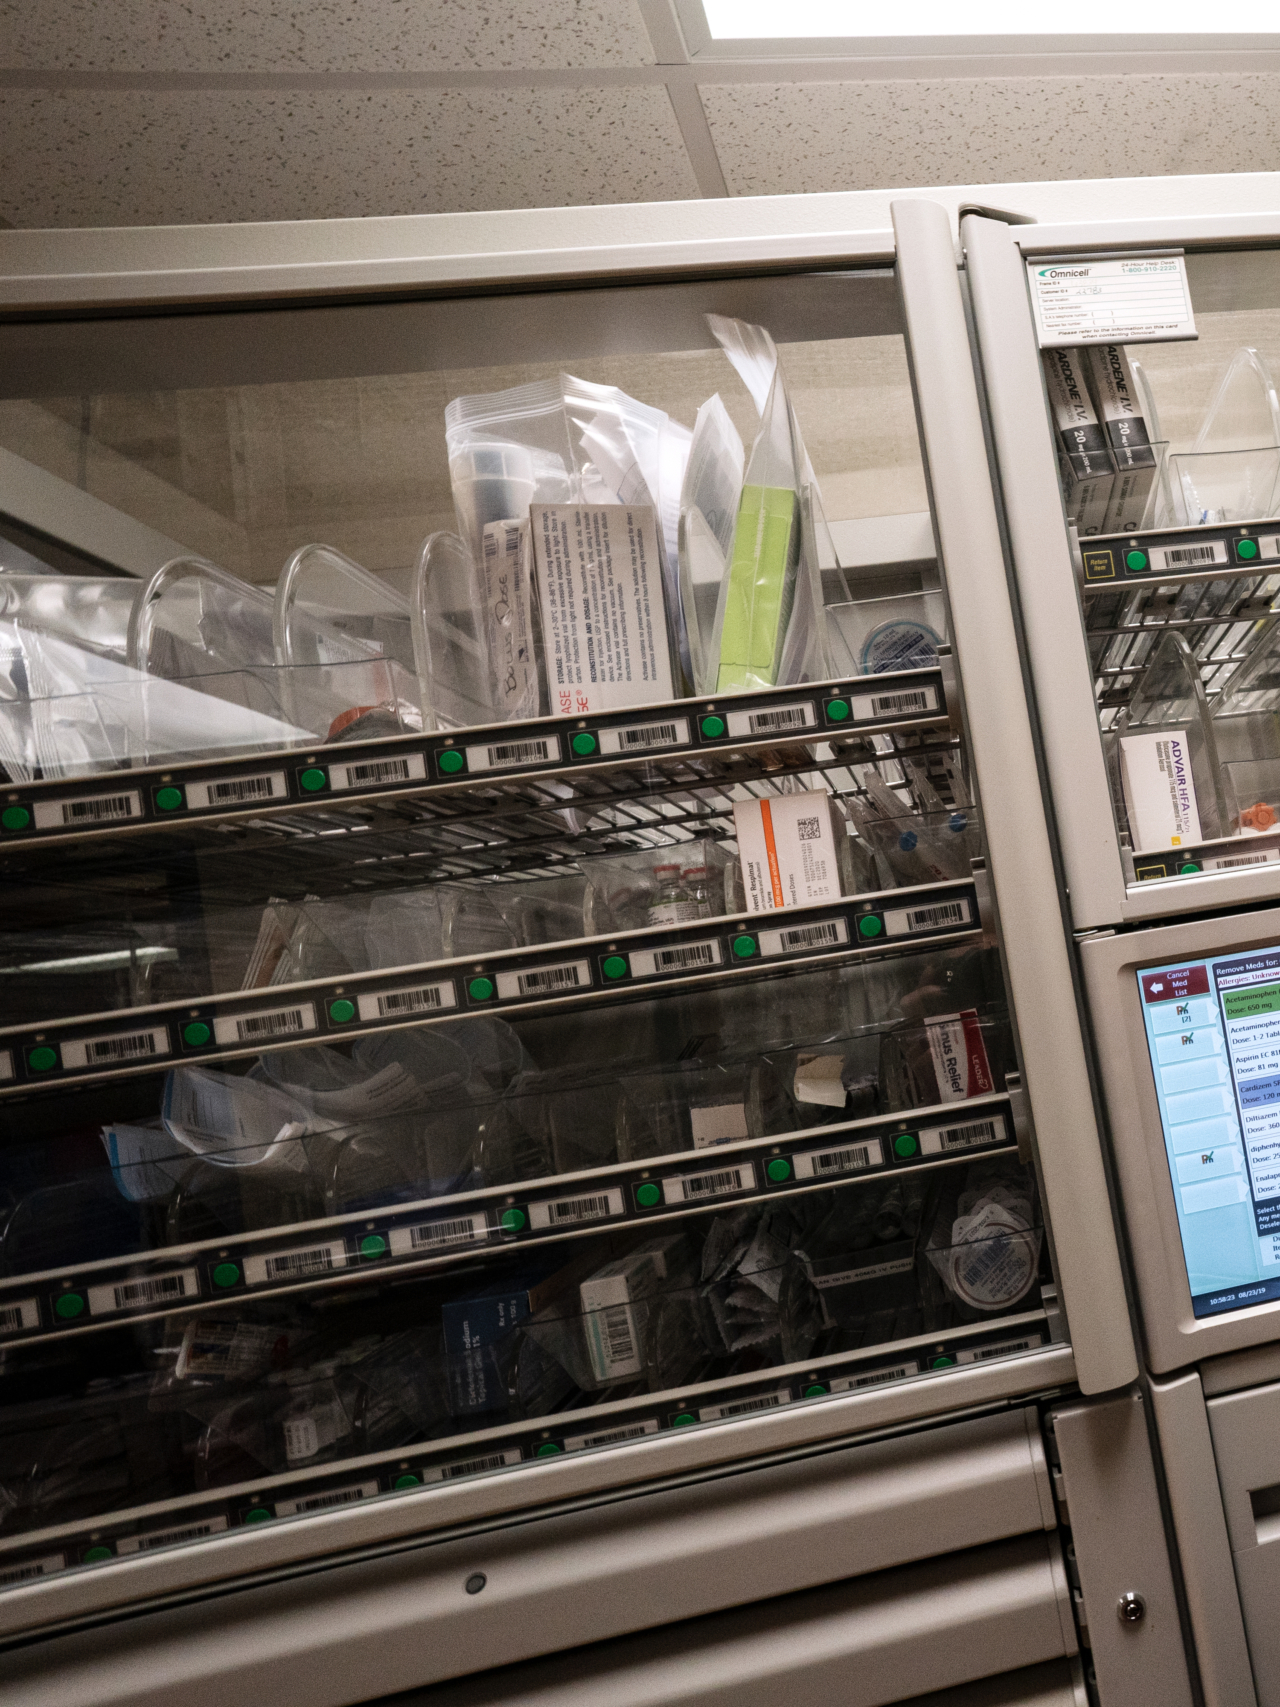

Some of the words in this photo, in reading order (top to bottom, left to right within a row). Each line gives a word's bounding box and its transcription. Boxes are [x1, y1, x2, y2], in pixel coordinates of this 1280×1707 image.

[1049, 269, 1089, 278] Omnicell
[1074, 430, 1086, 443] 20
[583, 597, 591, 620] DOSAGE:
[587, 637, 597, 682] RECONSTITUTION
[556, 657, 565, 684] STORAGE:
[1171, 740, 1186, 786] ADVAIR
[1179, 788, 1190, 811] HFA
[748, 862, 757, 892] Respimat
[1167, 970, 1189, 979] Cancel
[1216, 966, 1244, 975] Remove
[1246, 961, 1264, 970] Meds
[1218, 977, 1250, 986] Allergies:
[1226, 991, 1277, 1004] Acetaminophen
[1236, 1055, 1259, 1063] Aspirin
[945, 1057, 964, 1095] Relief
[972, 1054, 984, 1085] LEADER
[1240, 1083, 1272, 1093] Cardizem
[1246, 1113, 1278, 1123] Diltiazem
[1238, 1288, 1266, 1298] 08/23/19
